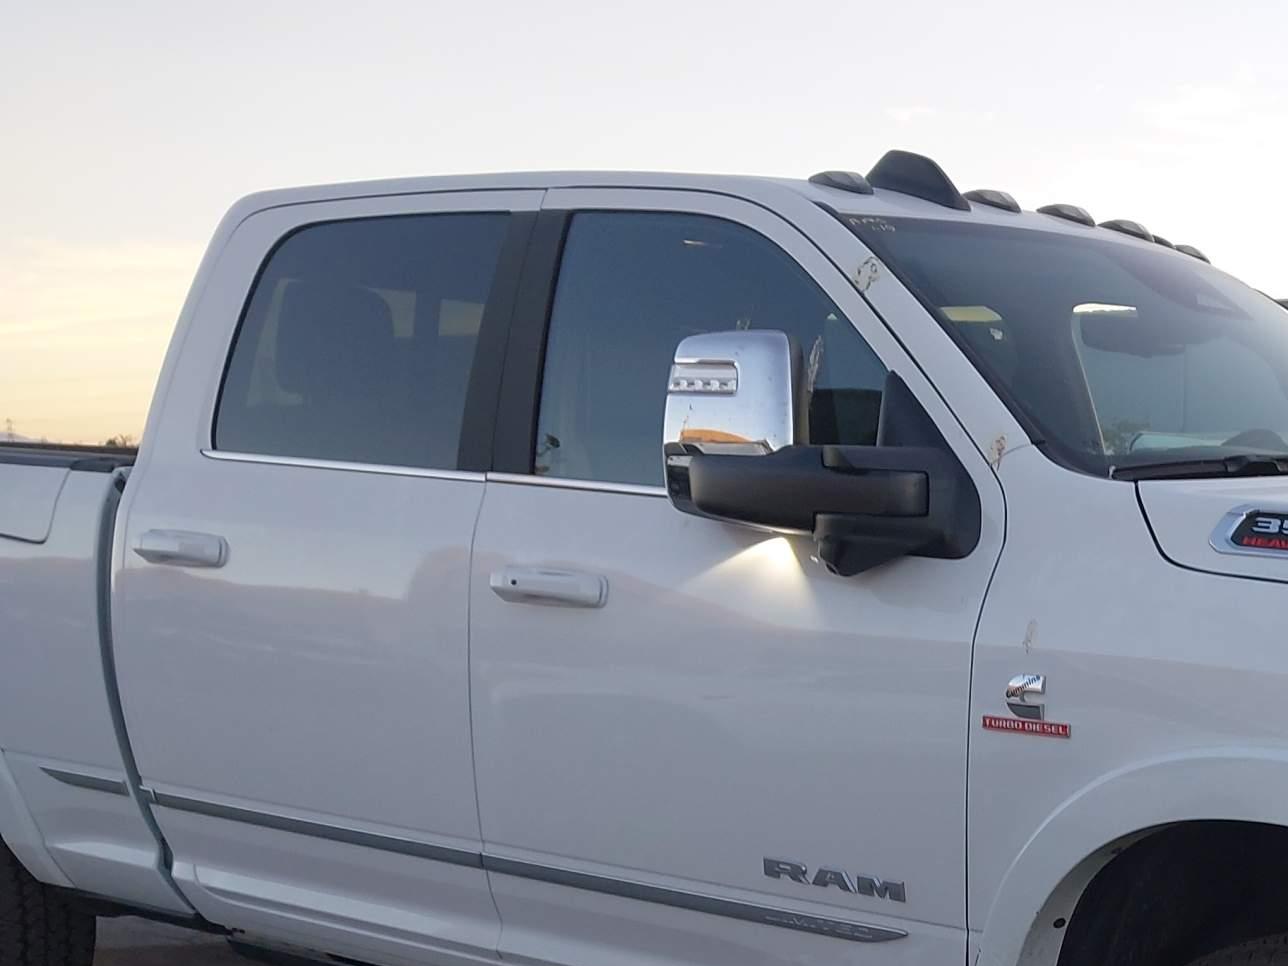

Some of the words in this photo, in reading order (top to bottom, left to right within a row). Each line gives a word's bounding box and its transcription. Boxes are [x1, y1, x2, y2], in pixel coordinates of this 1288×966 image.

[984, 717, 1022, 730] TURBO
[1024, 721, 1066, 735] DIESEL
[762, 856, 906, 903] RAM
